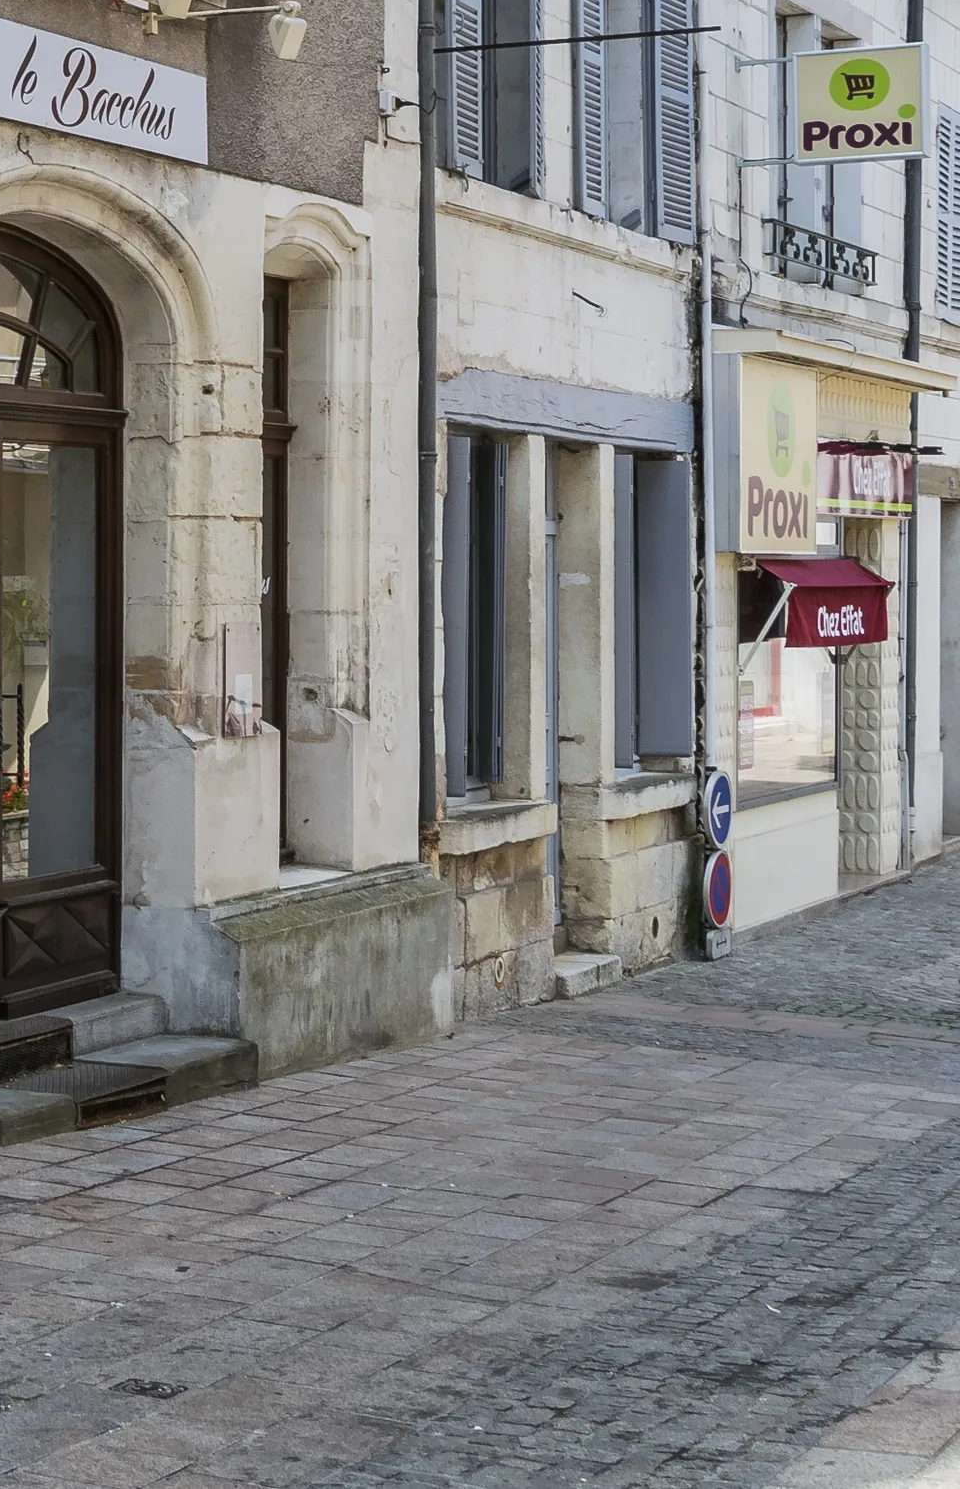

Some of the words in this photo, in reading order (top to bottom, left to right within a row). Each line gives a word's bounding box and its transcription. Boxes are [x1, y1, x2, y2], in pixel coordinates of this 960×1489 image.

[11, 34, 39, 105] le
[51, 46, 176, 141] Bacchus
[803, 103, 916, 152] Proxi
[748, 459, 812, 539] Proxi
[852, 458, 872, 495] Chez
[872, 460, 891, 497] Effat
[817, 605, 840, 637] Chez
[841, 604, 865, 636] Effat
